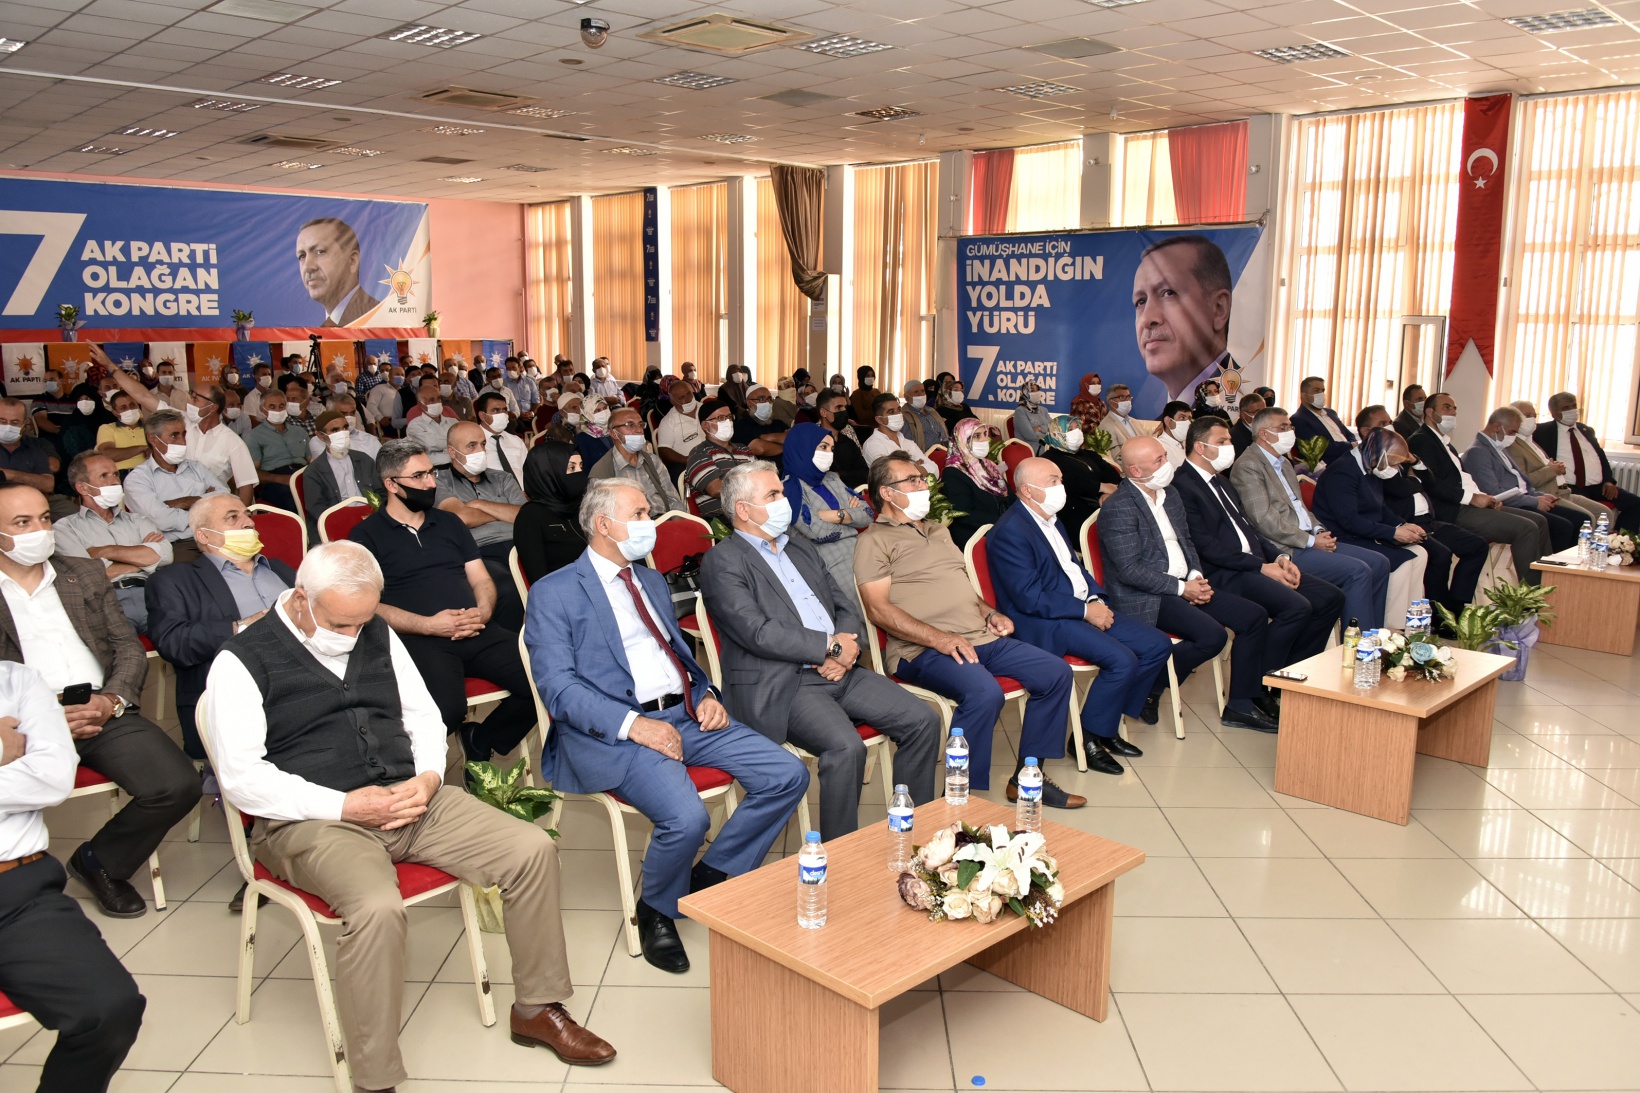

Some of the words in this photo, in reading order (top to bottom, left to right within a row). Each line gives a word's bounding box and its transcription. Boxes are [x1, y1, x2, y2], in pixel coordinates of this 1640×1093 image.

[80, 240, 126, 262] AK
[966, 242, 1044, 257] GÜMÜŞHANE
[1046, 239, 1071, 256] İÇİN
[82, 264, 219, 289] OLAĞAN
[84, 292, 219, 316] KONGRE
[966, 284, 1051, 308] YOLDA
[966, 311, 1036, 334] YÜRÜ
[996, 360, 1015, 373] AK
[997, 389, 1055, 405] KORE
